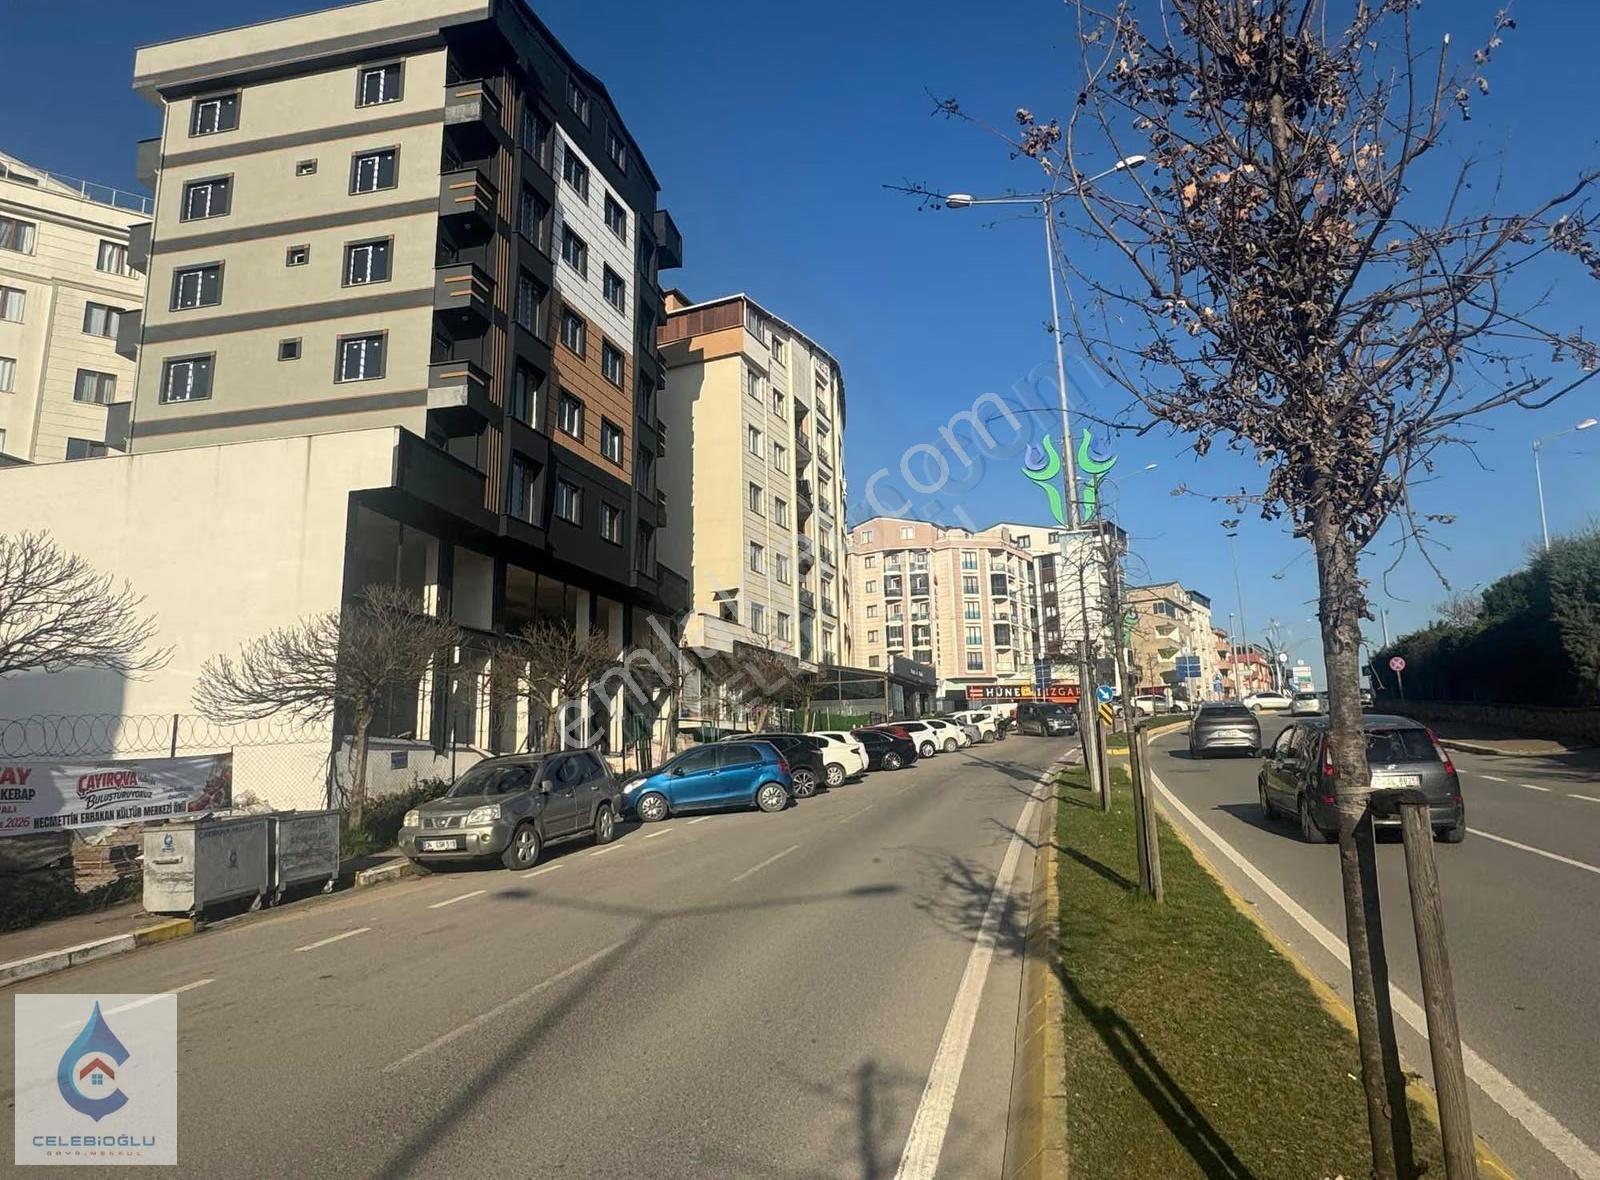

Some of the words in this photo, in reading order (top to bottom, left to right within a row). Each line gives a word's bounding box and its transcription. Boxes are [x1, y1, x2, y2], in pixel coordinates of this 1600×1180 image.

[0, 767, 32, 785] AY
[1, 788, 36, 801] KEBAP
[80, 809, 115, 824] ERBAKAN
[115, 805, 142, 820] KÜLTÜR
[143, 801, 172, 817] MERKEZİ
